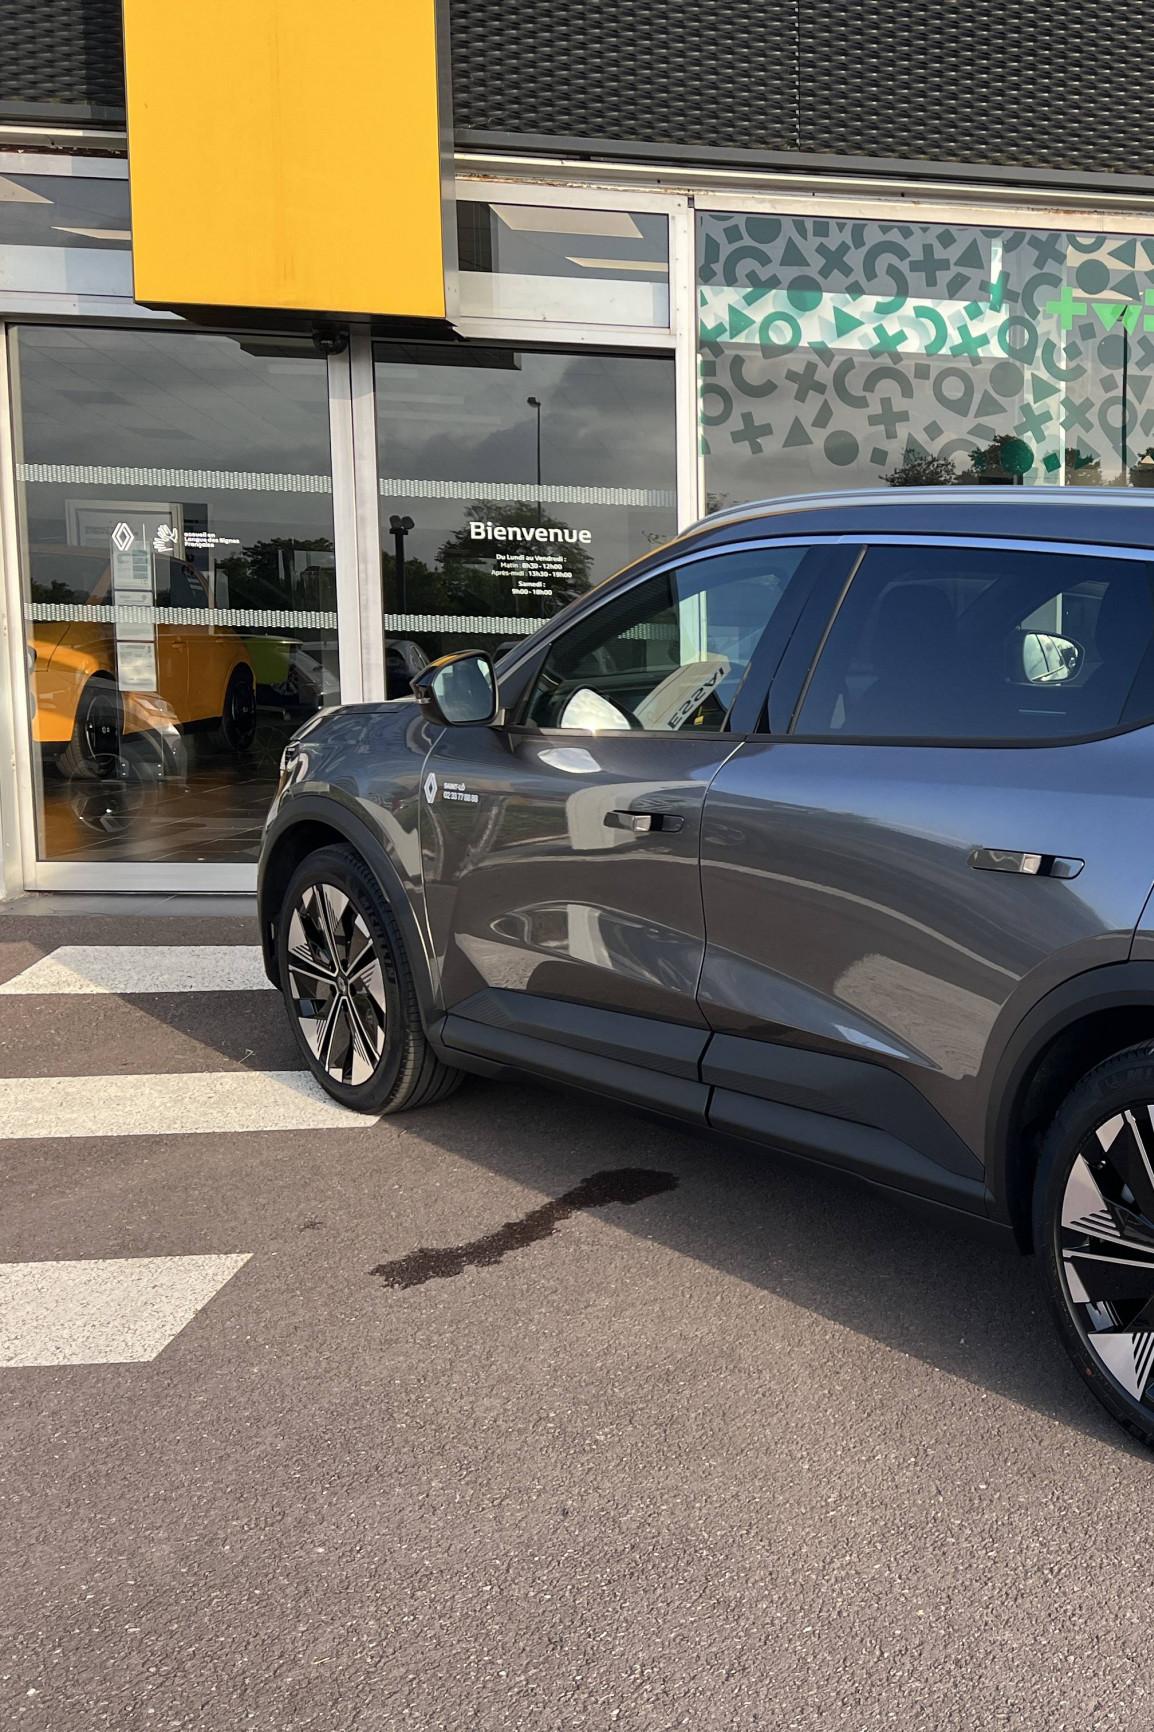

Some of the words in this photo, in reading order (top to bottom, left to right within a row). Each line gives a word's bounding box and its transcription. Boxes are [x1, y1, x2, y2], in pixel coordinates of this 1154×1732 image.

[469, 521, 592, 544] Bienvenue
[496, 553, 506, 561] Du
[491, 569, 525, 577] Après-midi
[518, 580, 543, 588] Samedi
